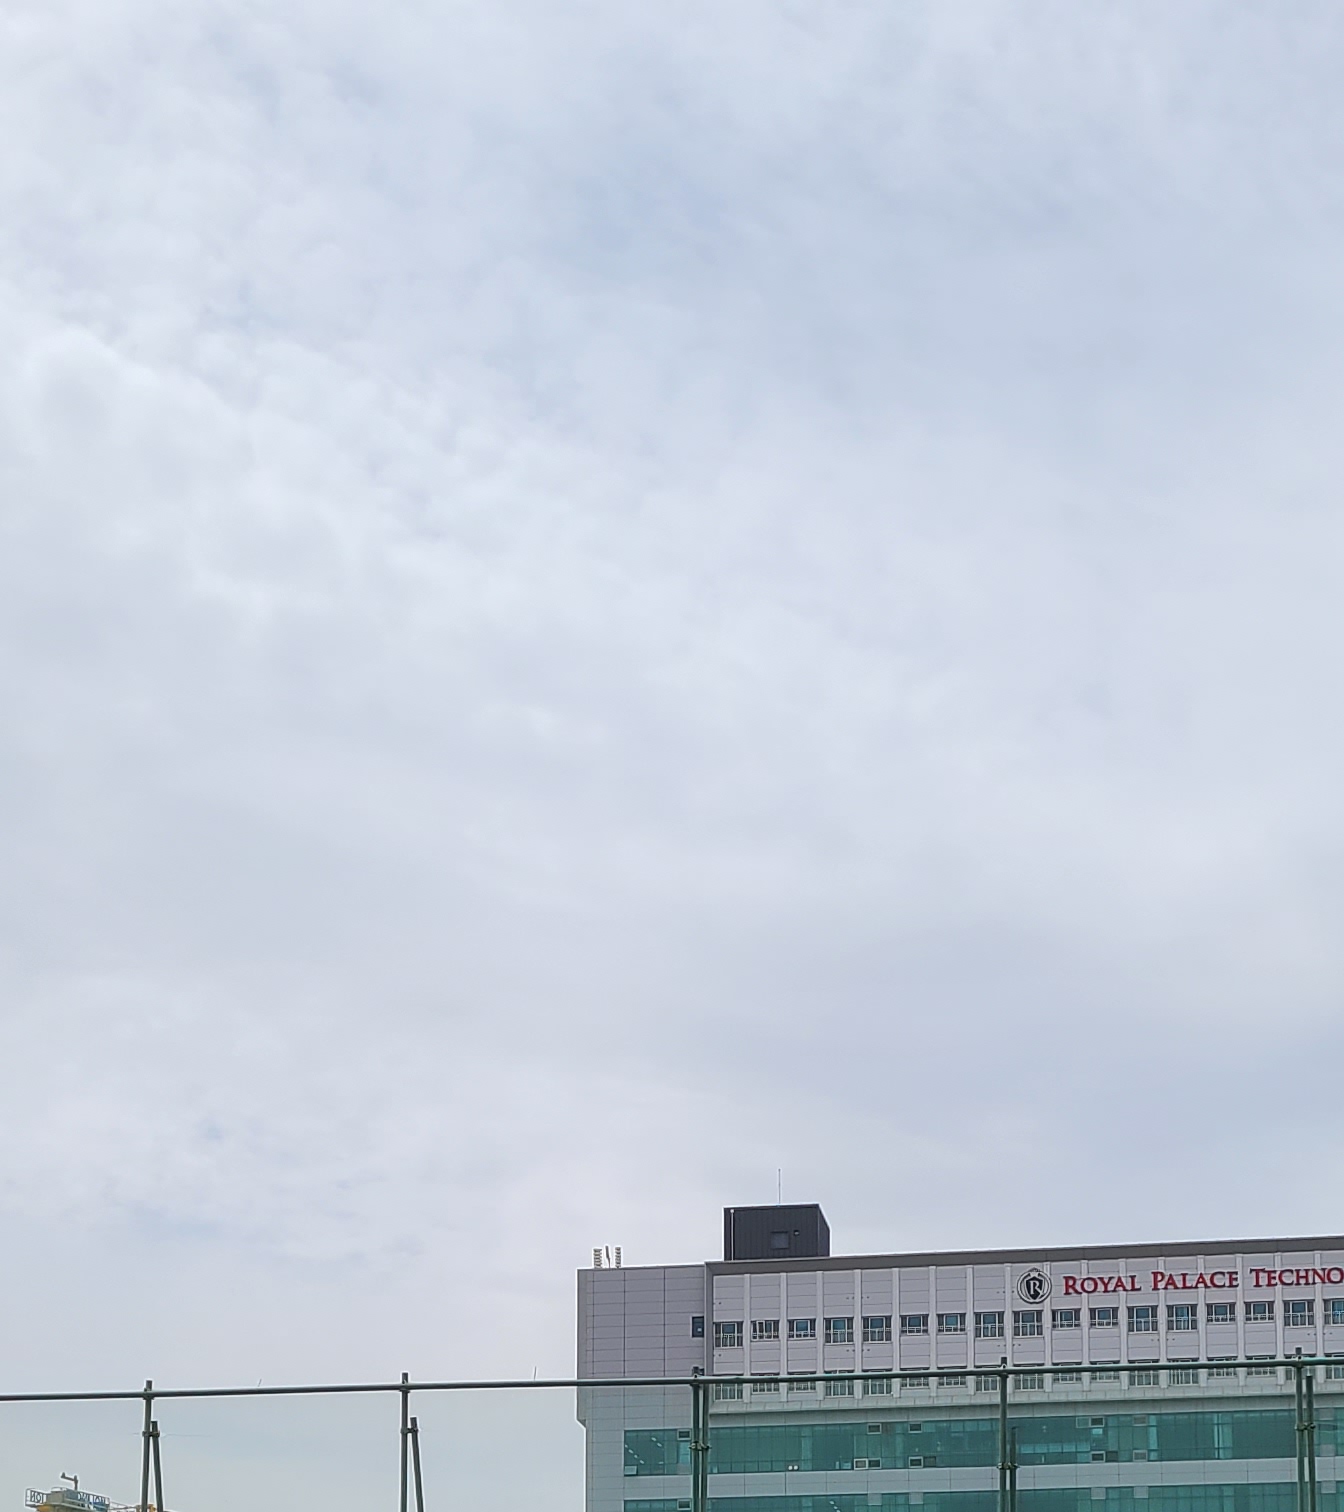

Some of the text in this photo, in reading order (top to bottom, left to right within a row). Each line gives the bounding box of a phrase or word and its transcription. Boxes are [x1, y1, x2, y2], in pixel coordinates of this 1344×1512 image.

[1063, 1275, 1141, 1295] ROYAL
[1151, 1270, 1239, 1291] PALACE
[1249, 1266, 1344, 1289] TECHNO
